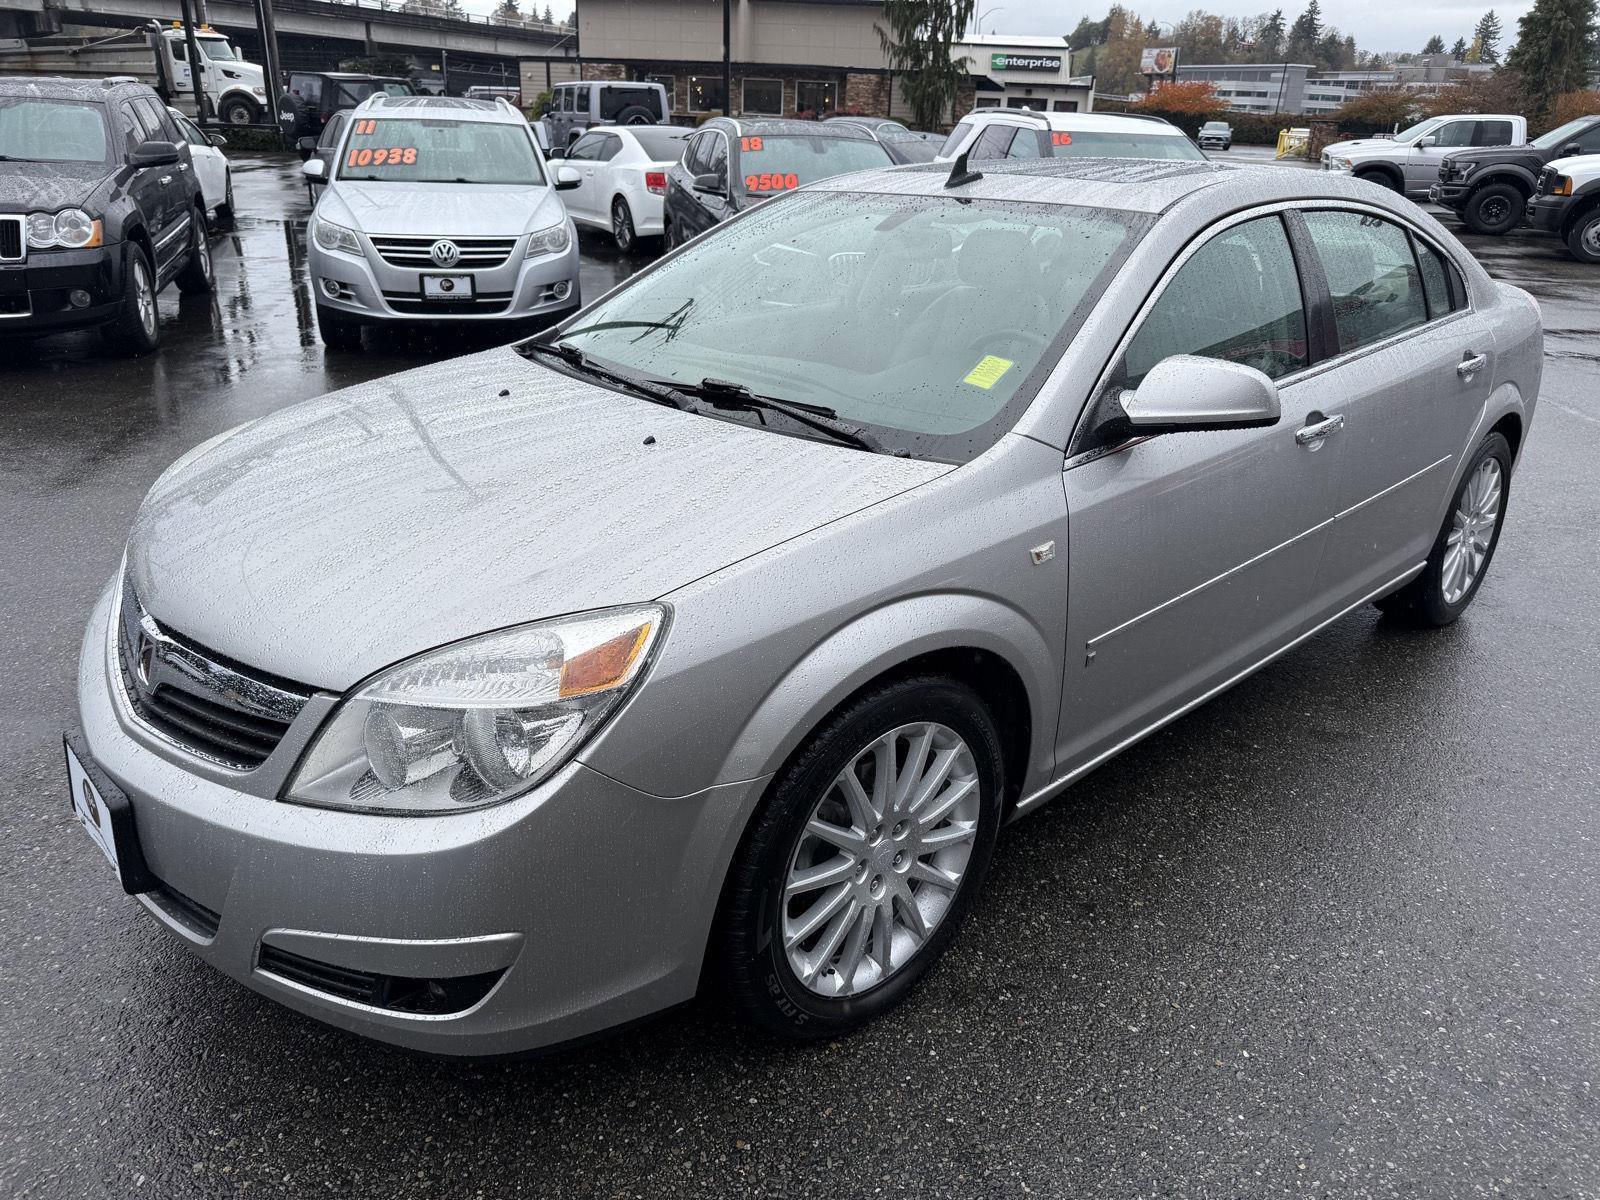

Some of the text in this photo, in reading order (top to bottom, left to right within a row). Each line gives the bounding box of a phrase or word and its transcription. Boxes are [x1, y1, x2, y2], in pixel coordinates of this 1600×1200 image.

[994, 57, 1060, 69] enterprise
[280, 110, 295, 122] Jeep
[356, 119, 377, 135] 11
[741, 136, 763, 152] 18
[1051, 132, 1072, 145] 16
[347, 148, 417, 168] 10938
[745, 173, 798, 192] 9500
